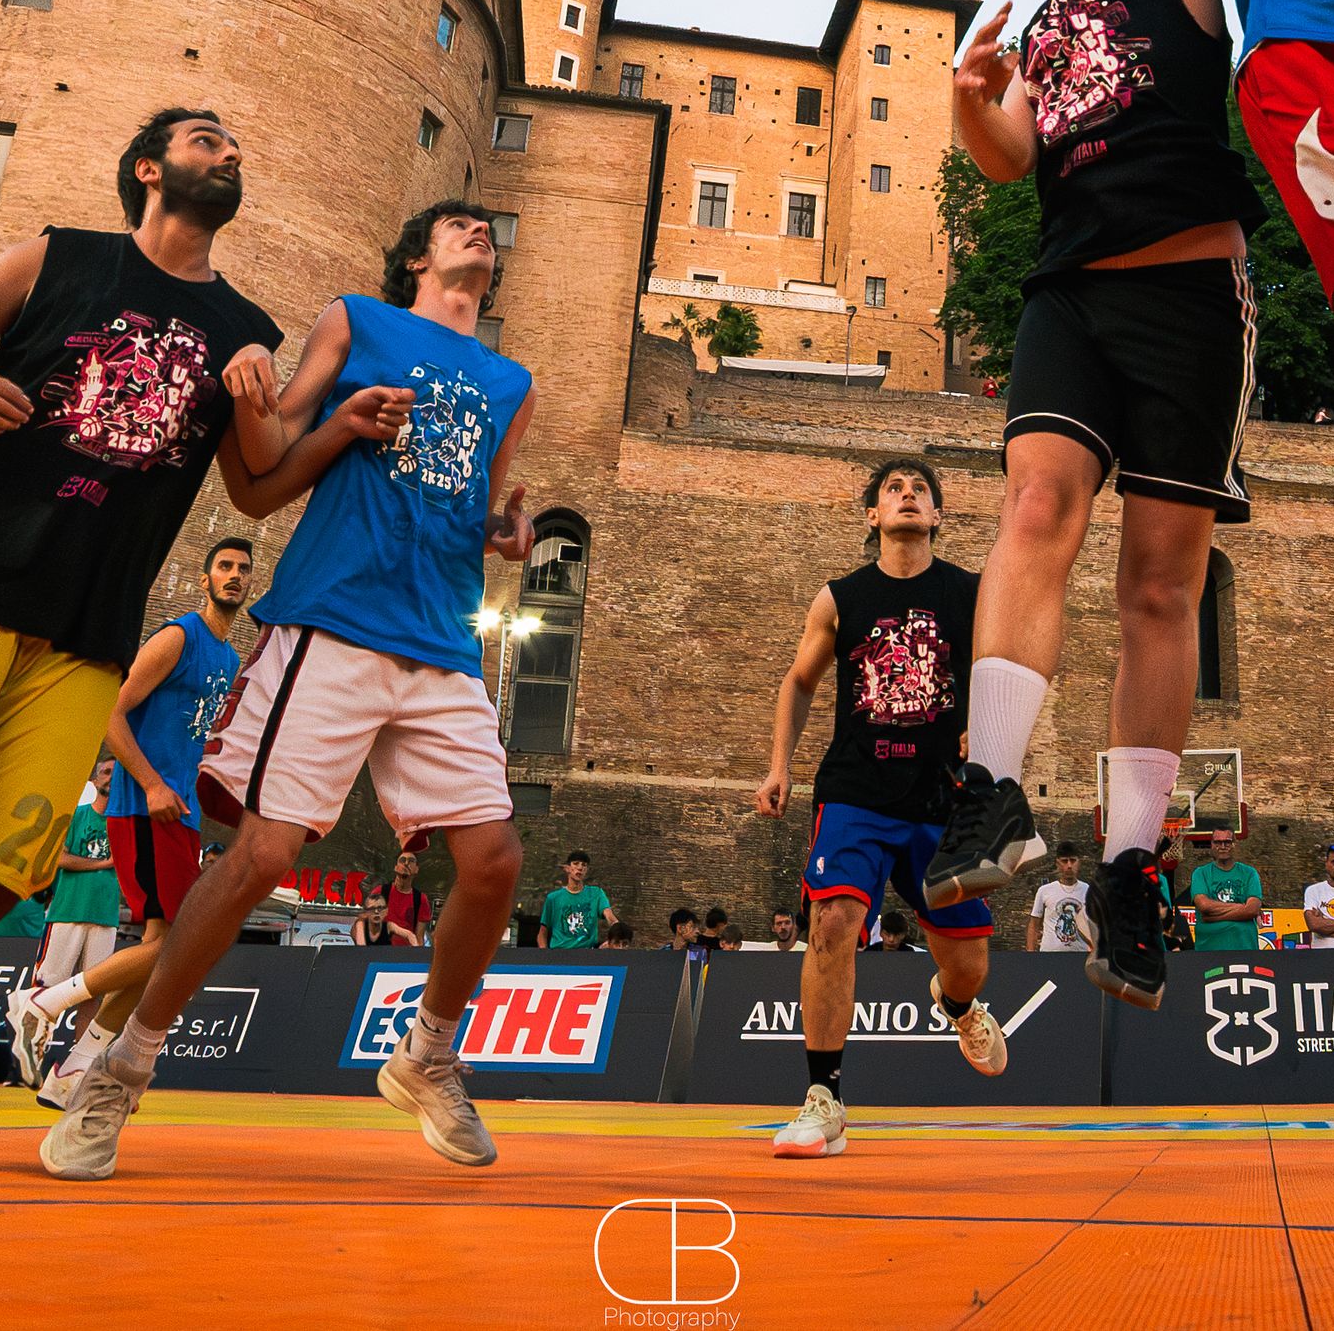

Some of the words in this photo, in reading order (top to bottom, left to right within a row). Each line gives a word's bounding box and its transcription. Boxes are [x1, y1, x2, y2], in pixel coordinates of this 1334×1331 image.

[107, 431, 153, 454] 2K25
[420, 468, 453, 491] 2K25
[890, 699, 921, 715] 2K25
[188, 1015, 238, 1037] s.r.l
[742, 1001, 918, 1032] ANNIO
[173, 1043, 228, 1059] CALDO
